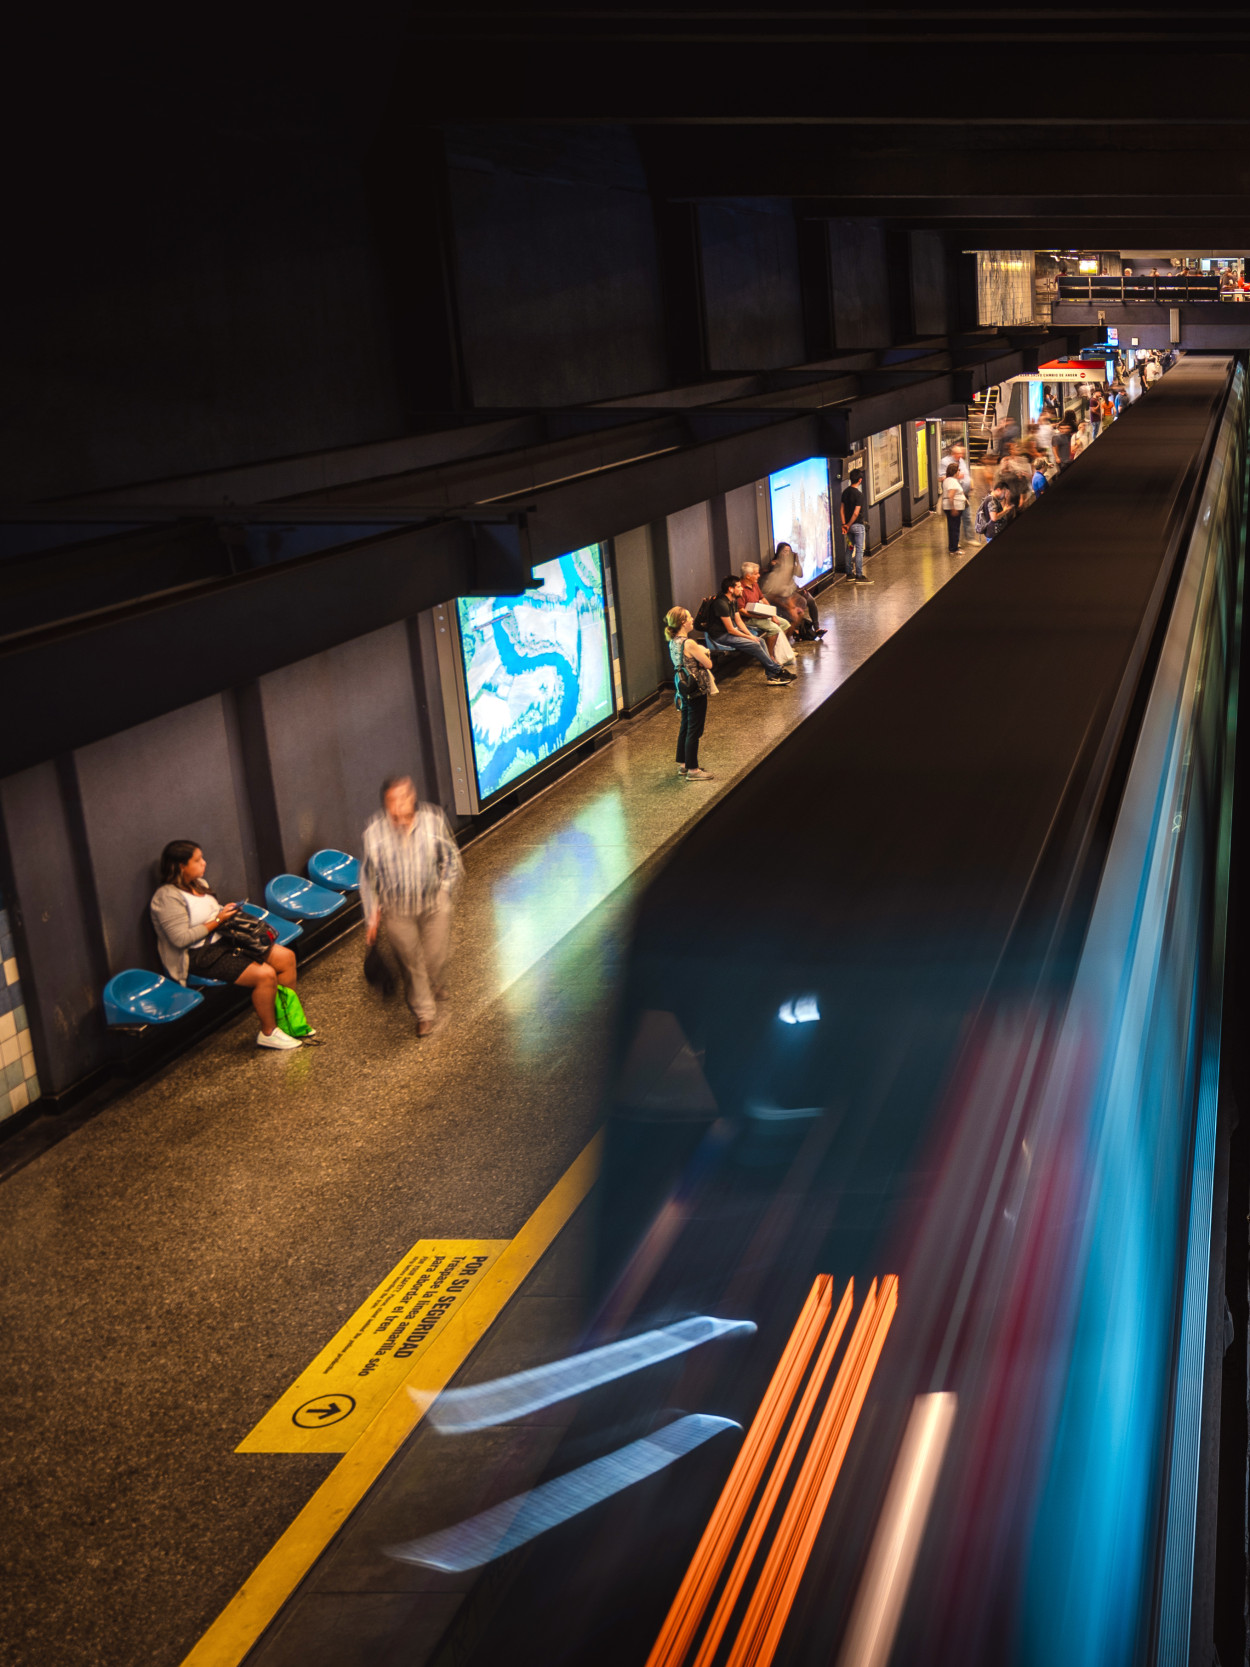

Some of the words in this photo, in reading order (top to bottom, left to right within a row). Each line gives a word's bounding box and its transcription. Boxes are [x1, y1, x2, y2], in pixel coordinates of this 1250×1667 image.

[425, 1255, 446, 1273] para
[429, 1255, 467, 1289] Traspase
[458, 1256, 489, 1276] POR
[399, 1274, 431, 1305] abordar
[421, 1290, 438, 1299] la
[445, 1278, 470, 1293] SU
[391, 1305, 405, 1314] el
[373, 1315, 399, 1335] tren.
[393, 1295, 457, 1359] SEGURIDAD
[374, 1321, 410, 1356] amarilla
[357, 1357, 381, 1377] sólo
